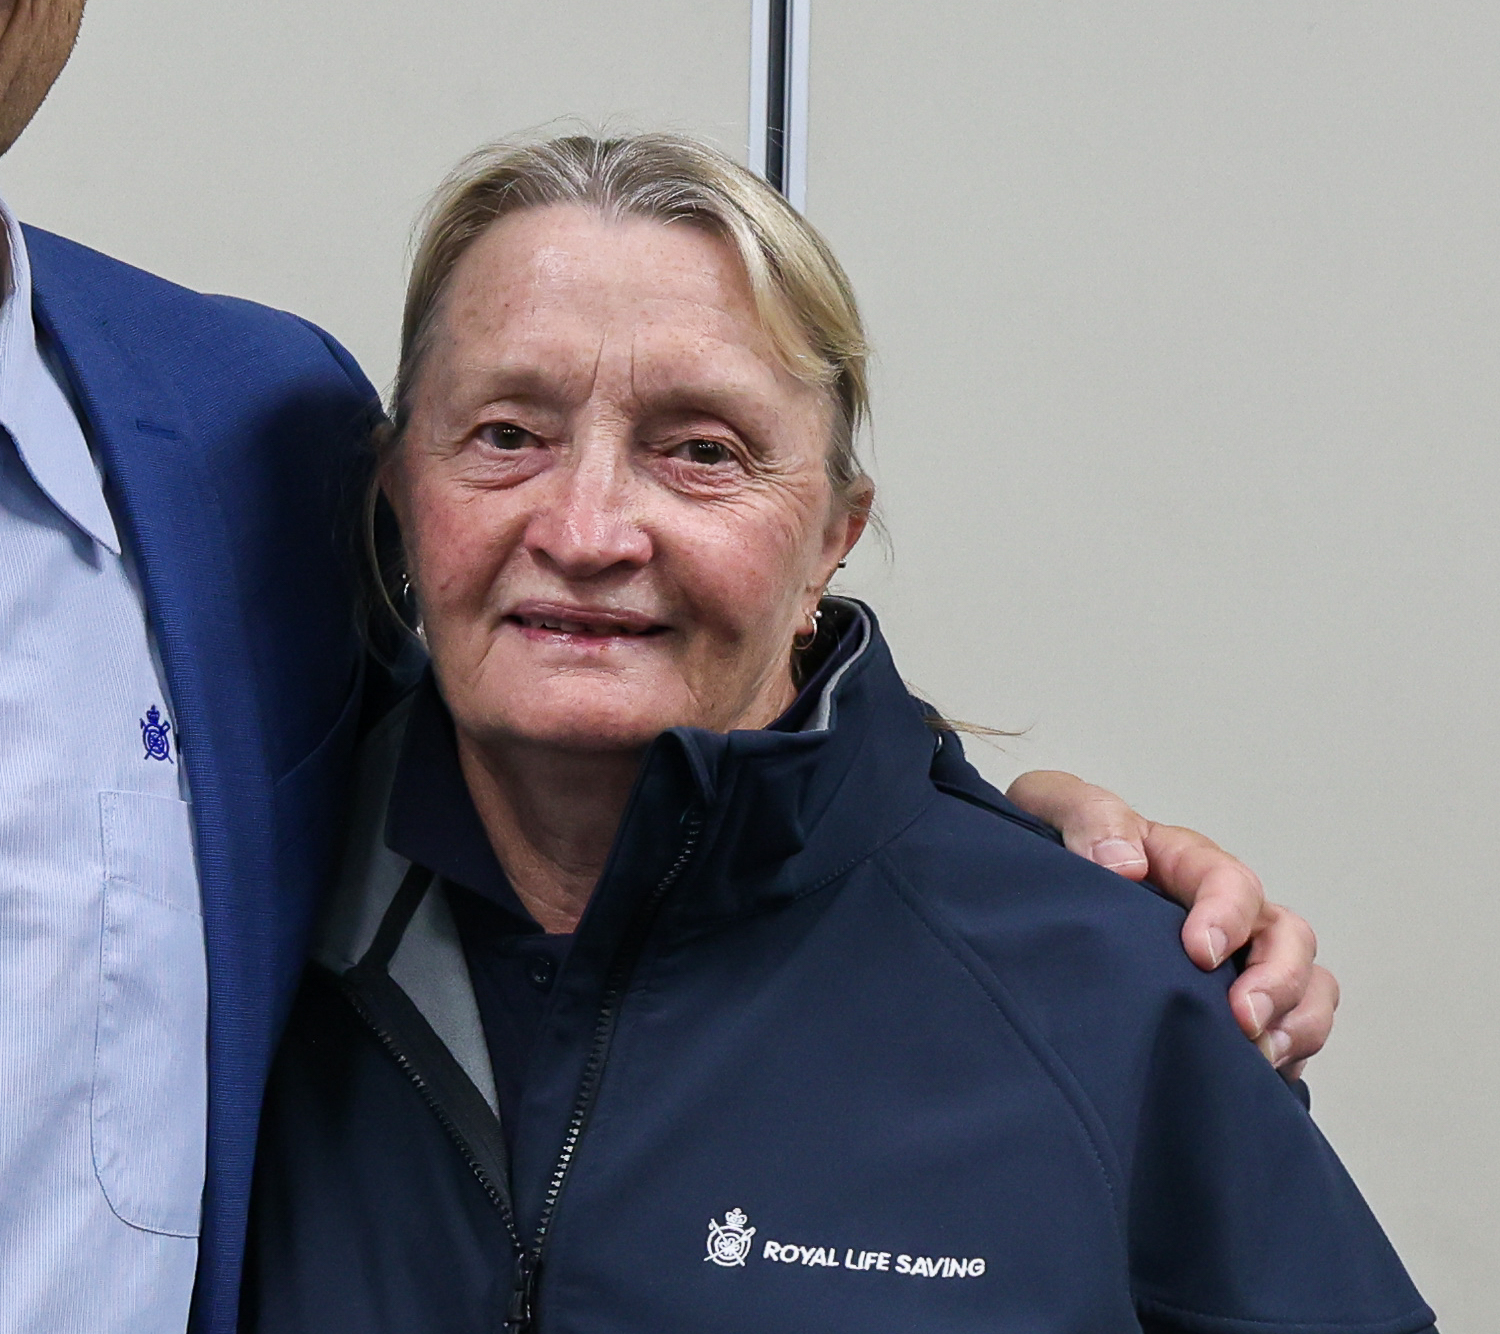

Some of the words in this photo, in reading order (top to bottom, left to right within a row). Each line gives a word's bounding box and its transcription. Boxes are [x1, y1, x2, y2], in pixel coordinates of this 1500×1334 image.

[763, 1240, 839, 1267] ROYAL
[845, 1248, 892, 1271] LIFE
[894, 1254, 986, 1278] SAVING
